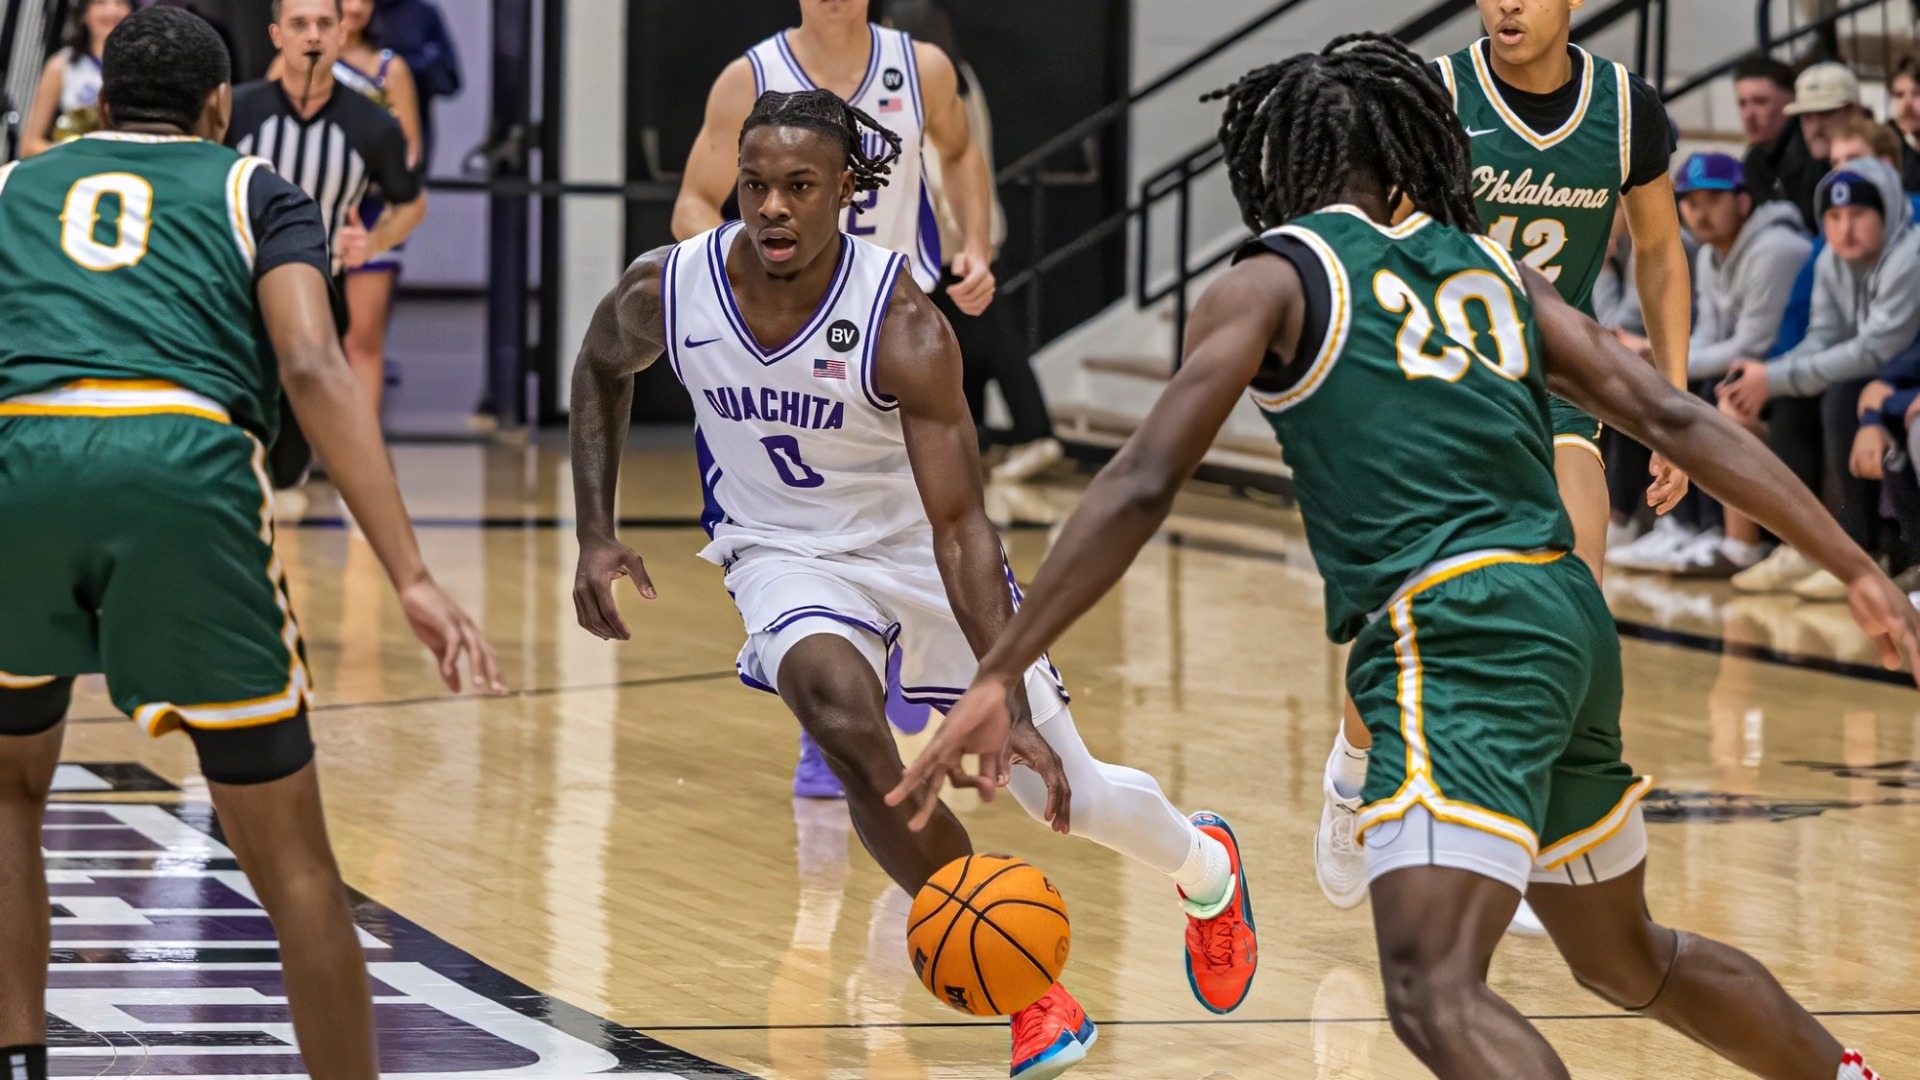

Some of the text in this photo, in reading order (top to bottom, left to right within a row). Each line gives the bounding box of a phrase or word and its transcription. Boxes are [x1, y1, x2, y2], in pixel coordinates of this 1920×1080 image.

[1471, 165, 1609, 208] Oklahoma
[59, 171, 153, 271] 0
[1487, 215, 1569, 284] 12
[831, 328, 855, 344] BV
[1373, 269, 1525, 382] 20
[703, 387, 844, 429] OUACHITA
[759, 434, 825, 488] 0
